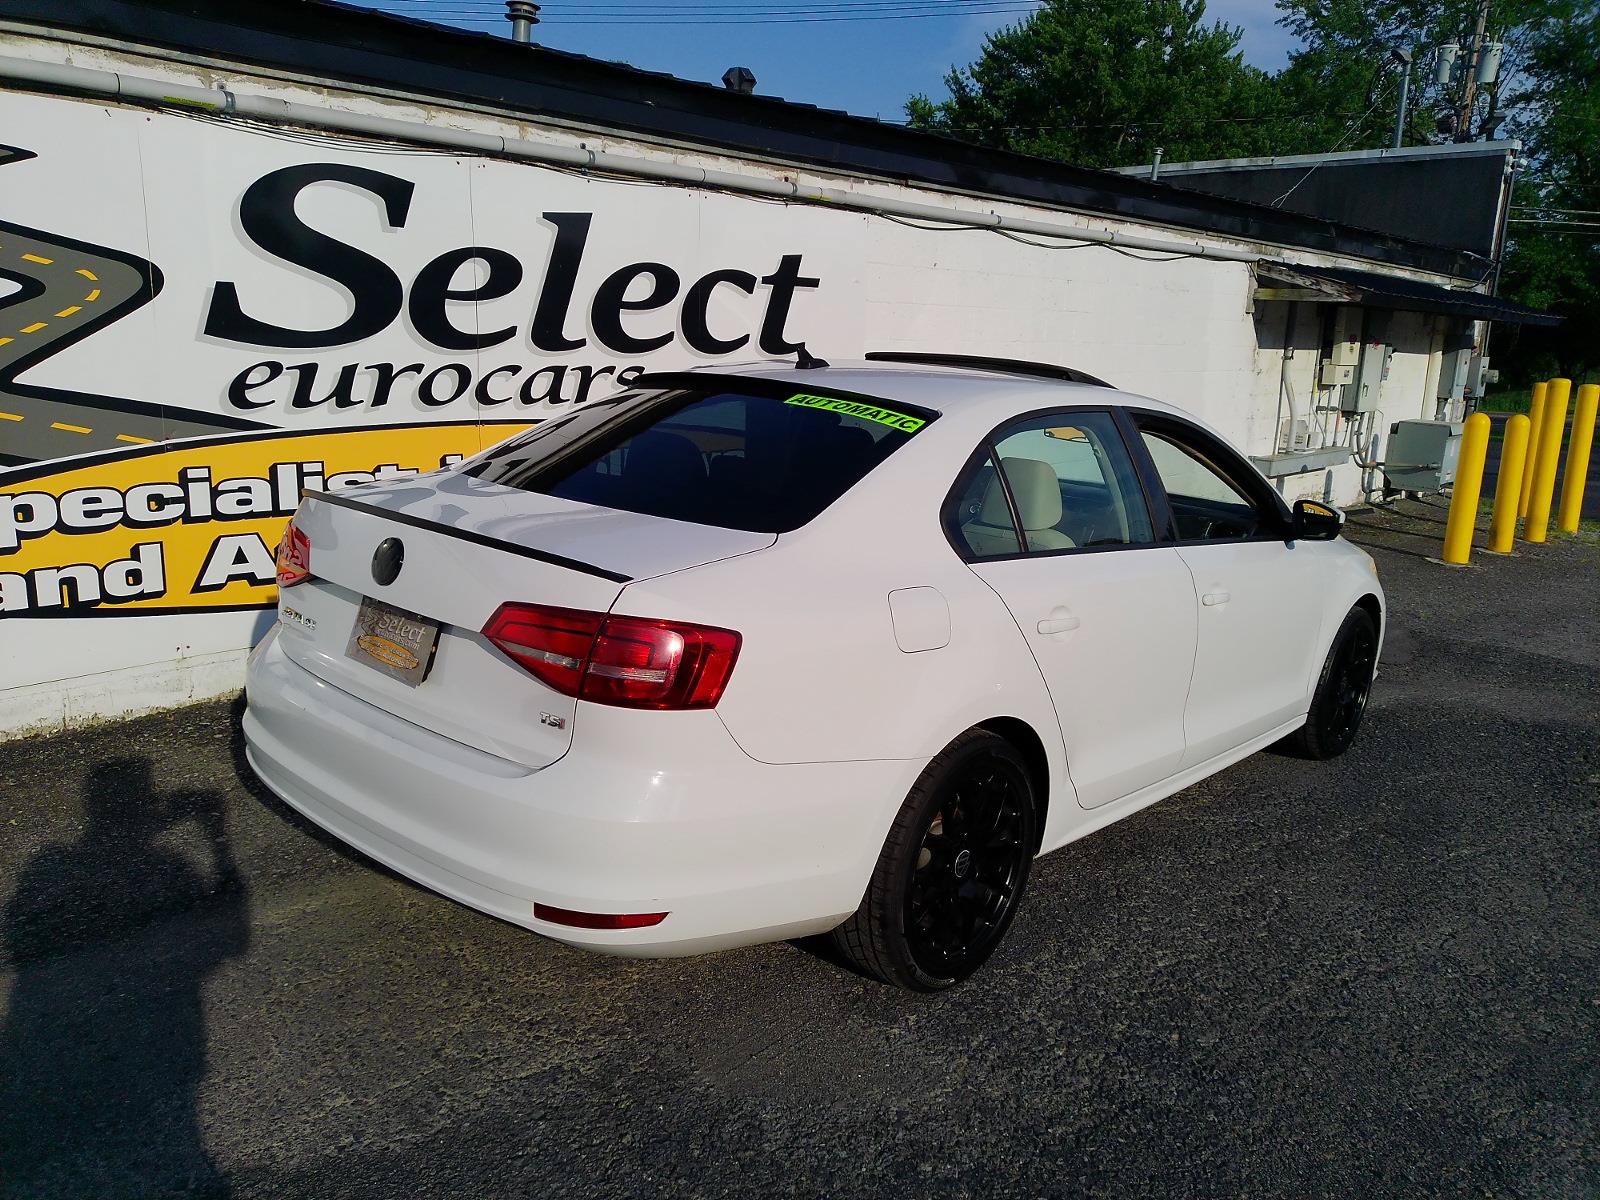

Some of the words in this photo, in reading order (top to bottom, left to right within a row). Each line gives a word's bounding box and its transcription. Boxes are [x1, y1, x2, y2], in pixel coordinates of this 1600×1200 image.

[204, 163, 820, 354] Select
[228, 359, 646, 410] eurocars
[790, 395, 919, 430] AUTOMATIC
[378, 612, 426, 643] Select
[540, 712, 566, 729] TSI
